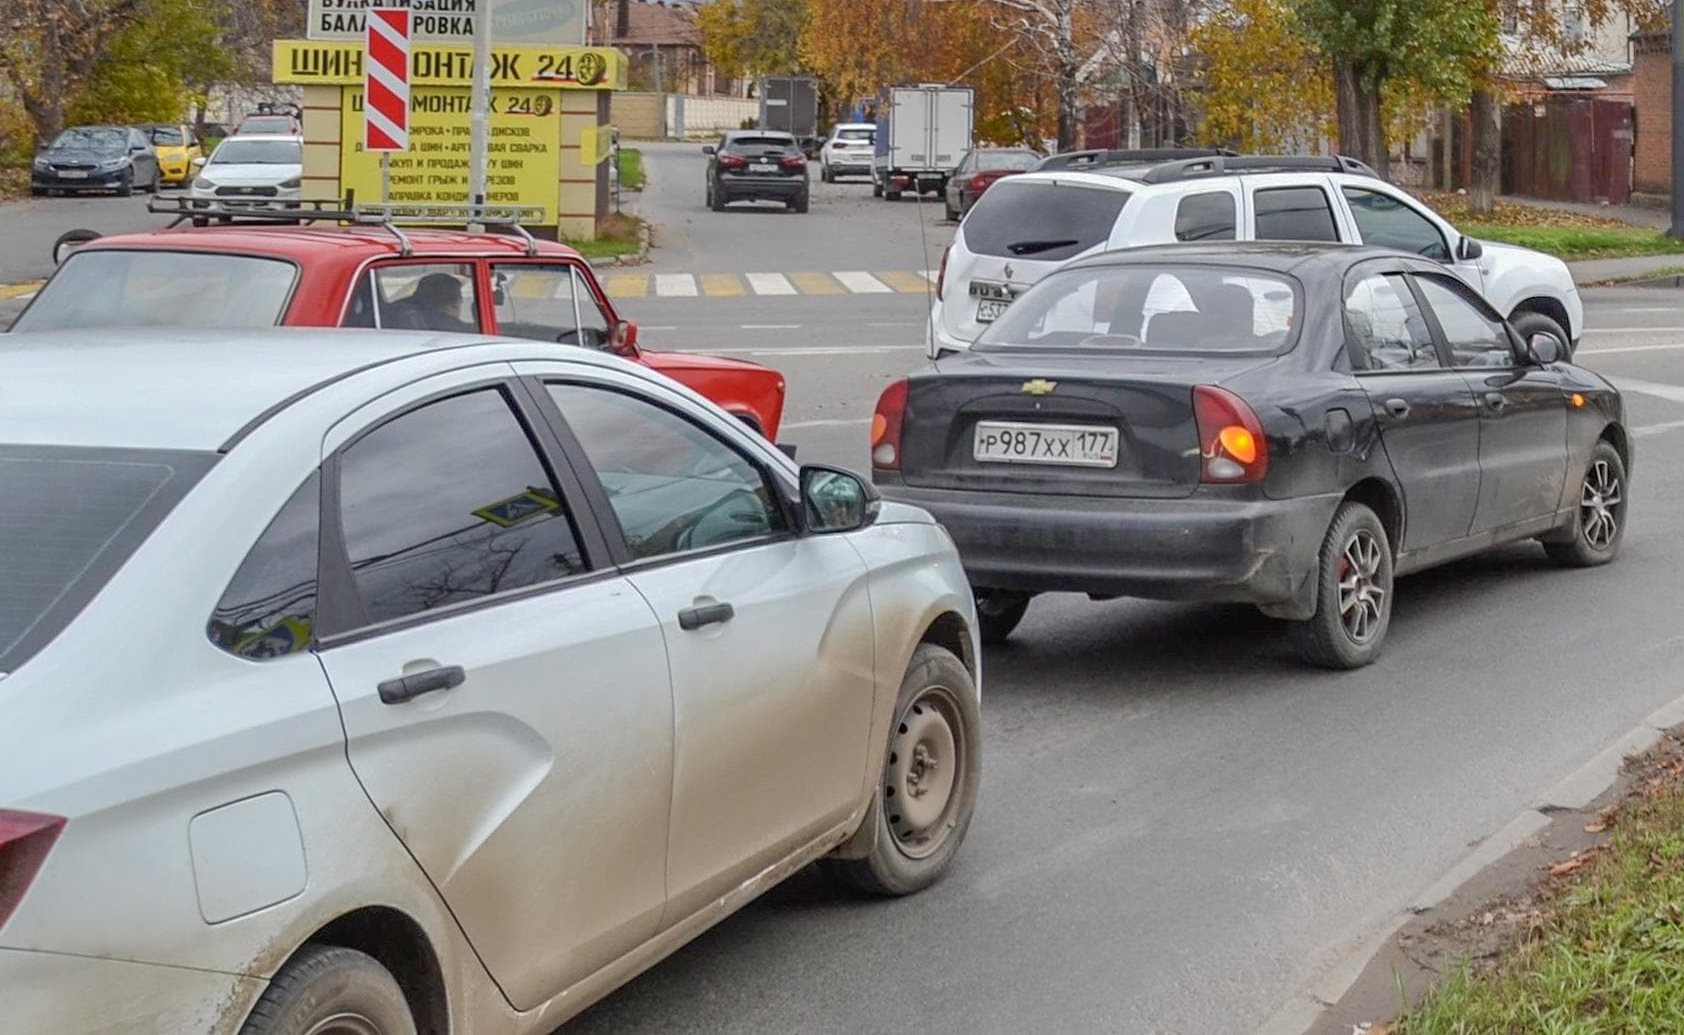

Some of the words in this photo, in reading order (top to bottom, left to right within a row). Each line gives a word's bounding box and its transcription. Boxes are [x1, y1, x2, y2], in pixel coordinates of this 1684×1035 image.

[321, 13, 474, 36] БАЛРОВКА
[291, 49, 521, 80] ШИНОНТЖ
[538, 54, 574, 80] 24
[508, 96, 531, 114] 24
[450, 143, 506, 153] АРГВАЯ
[509, 143, 548, 153] СВАРКА
[427, 159, 471, 169] ПРОДАЖ
[485, 175, 516, 185] РЕЗОВ
[389, 191, 433, 201] АПРАВКА
[436, 191, 519, 202] КОНДИНЕРОВ
[1077, 432, 1109, 452] 177
